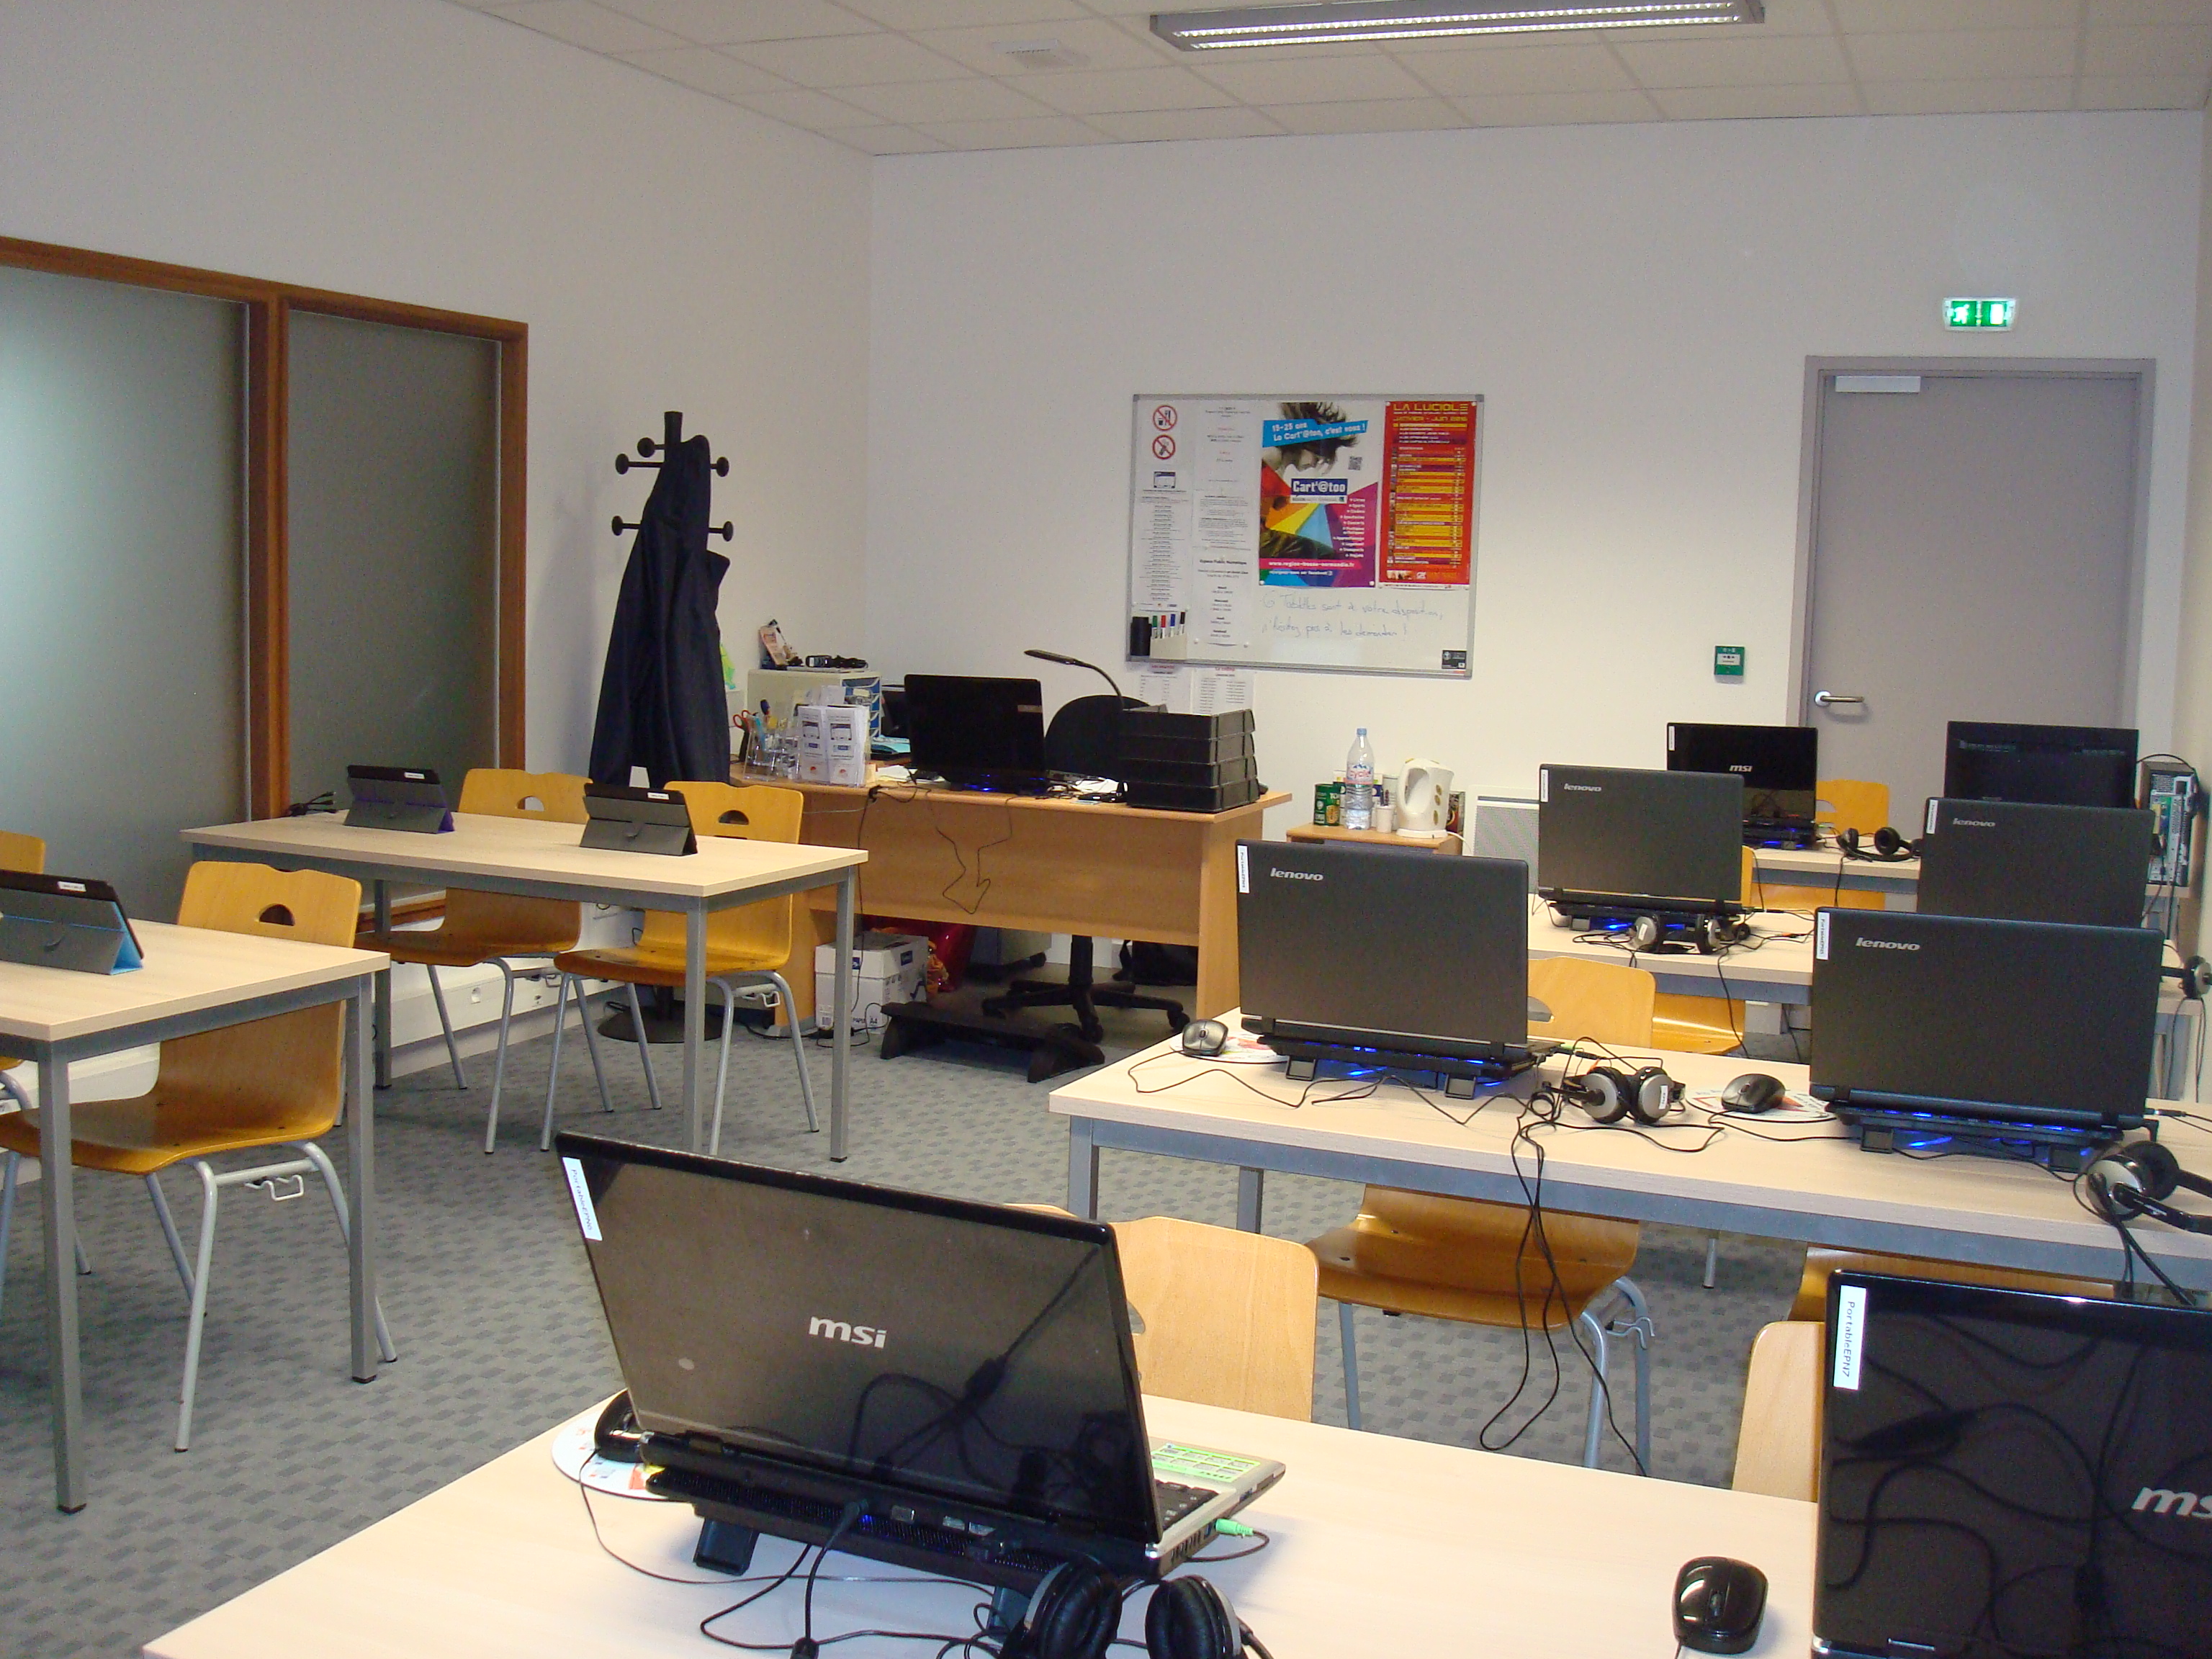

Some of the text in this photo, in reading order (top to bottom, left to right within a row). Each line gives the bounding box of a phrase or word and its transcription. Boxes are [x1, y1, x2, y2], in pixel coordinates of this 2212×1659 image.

[1292, 480, 1346, 493] Cart'@too
[1563, 783, 1602, 792] lenovo
[1952, 817, 1996, 827] lenovo
[1270, 867, 1323, 881] lenovo
[1856, 937, 1920, 950] lenovo
[809, 1316, 887, 1349] msi
[1843, 1301, 1856, 1377] PortableEPN7
[2131, 1487, 2212, 1519] ms
